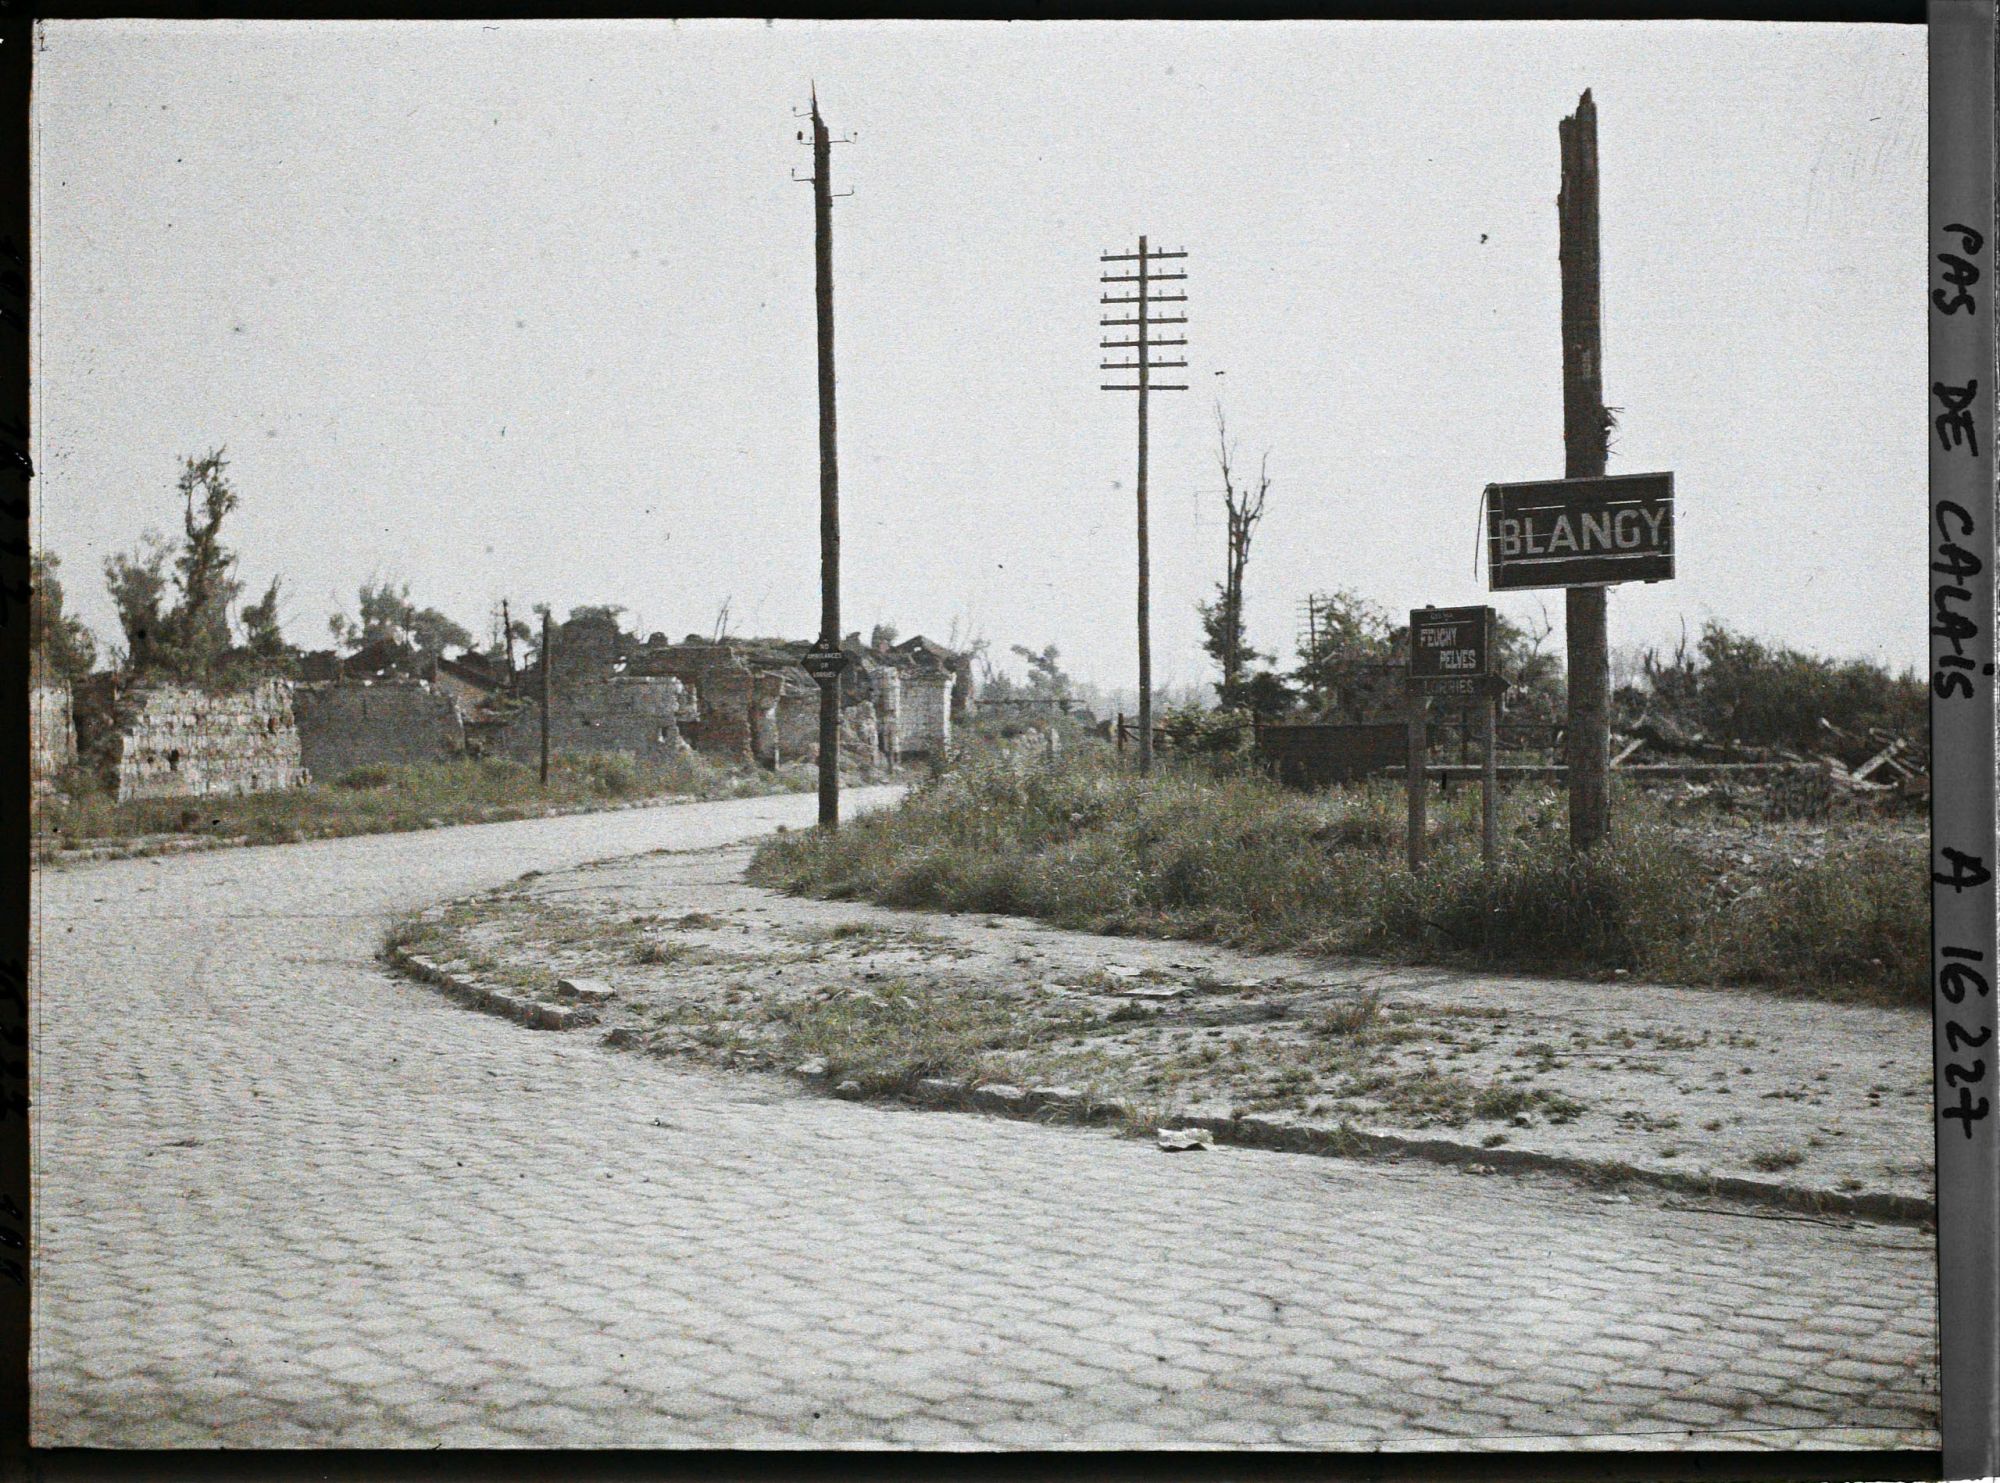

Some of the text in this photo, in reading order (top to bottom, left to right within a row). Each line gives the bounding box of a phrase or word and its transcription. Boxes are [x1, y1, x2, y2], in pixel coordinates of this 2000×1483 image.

[1932, 223, 1984, 315] PAS
[1932, 379, 1979, 457] DE
[1499, 506, 1667, 556] BLANGY
[1420, 627, 1458, 648] FEUCHY
[1439, 649, 1477, 669] PELVES
[1932, 847, 1991, 893] A
